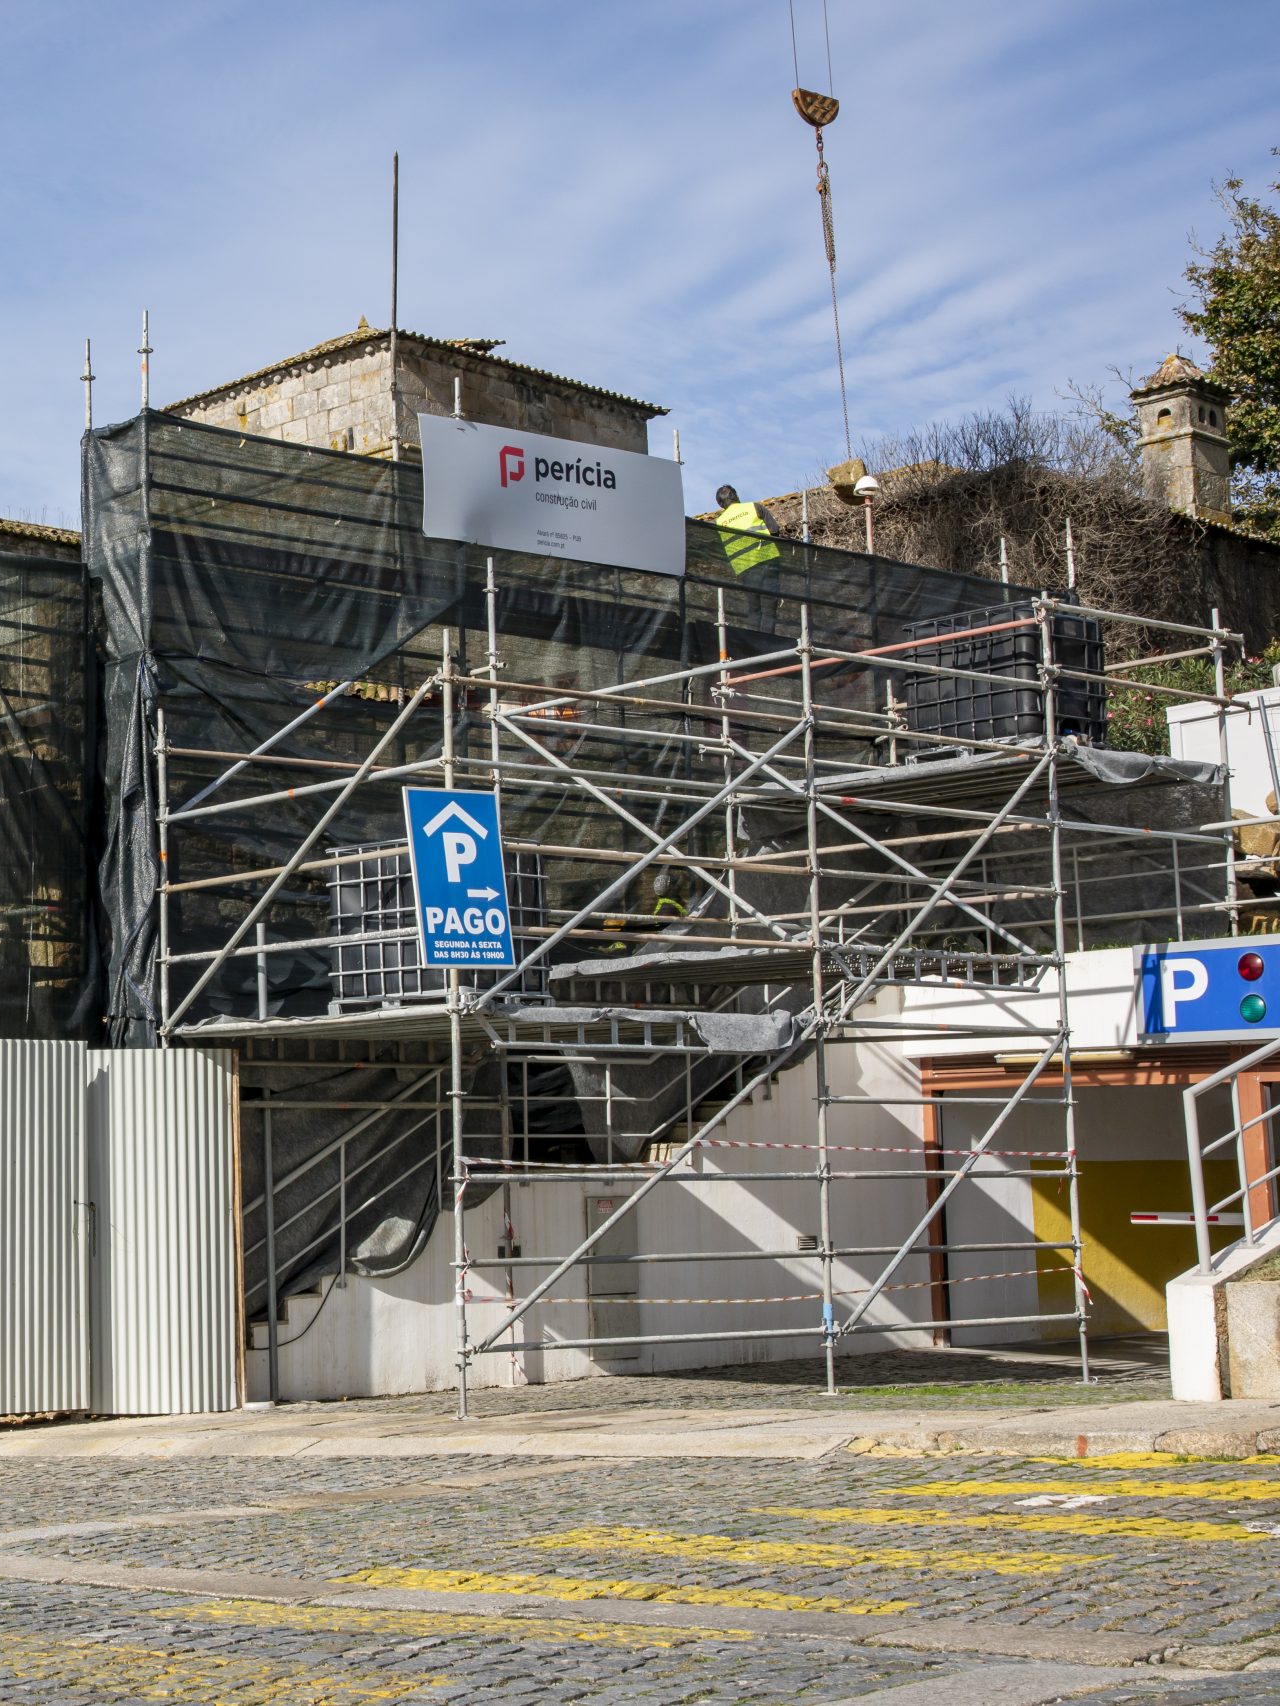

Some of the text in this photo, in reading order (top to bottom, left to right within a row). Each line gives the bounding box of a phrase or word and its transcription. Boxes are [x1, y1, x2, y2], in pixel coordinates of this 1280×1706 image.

[534, 457, 616, 490] perícia
[535, 491, 597, 511] construção civil
[442, 832, 477, 883] P
[425, 906, 506, 935] PAGO
[433, 949, 504, 959] DAS 8H30 ÀS 19H00
[434, 940, 502, 949] SEGUNDA A SEXTA
[1160, 957, 1208, 1028] P
